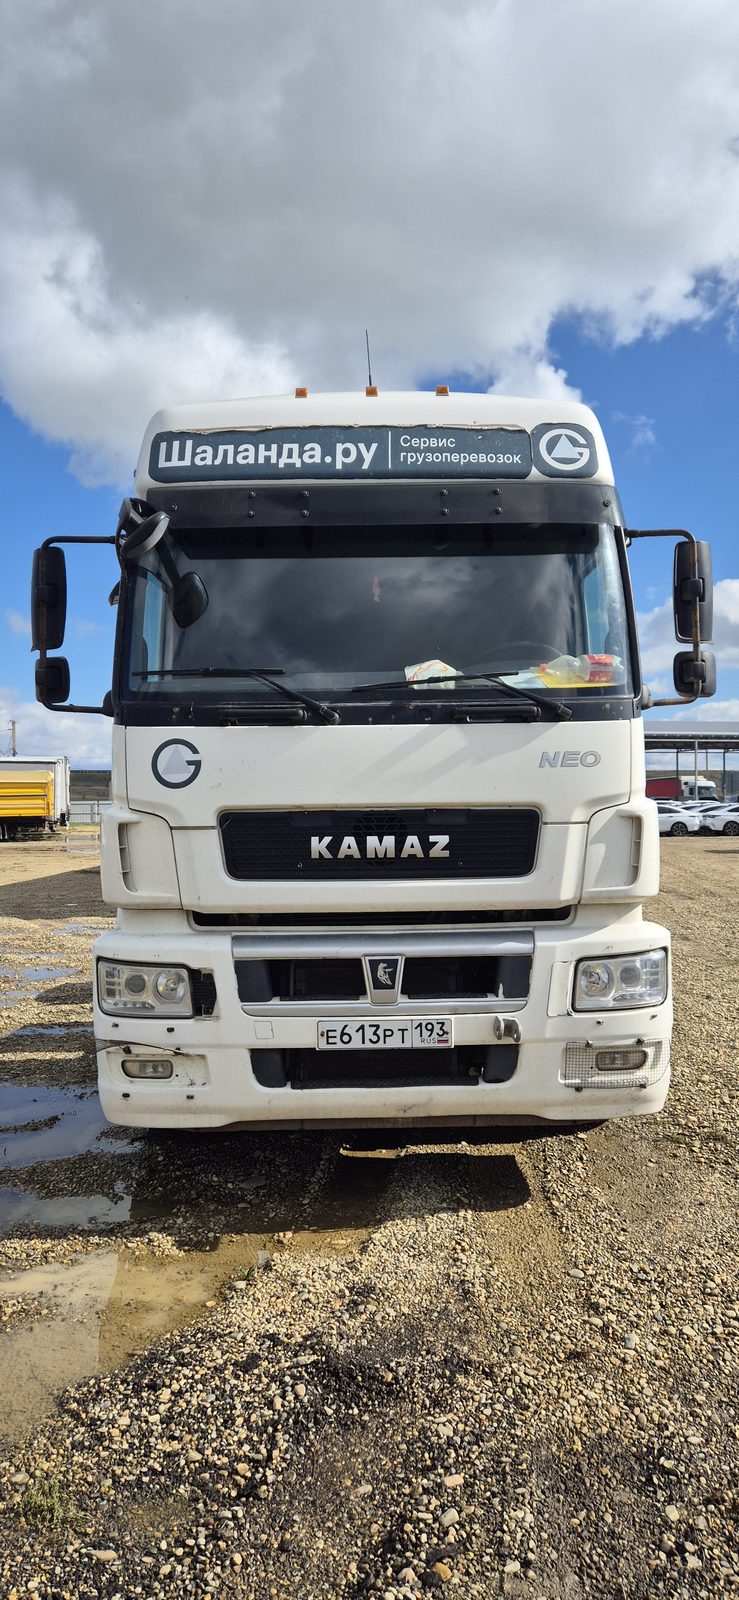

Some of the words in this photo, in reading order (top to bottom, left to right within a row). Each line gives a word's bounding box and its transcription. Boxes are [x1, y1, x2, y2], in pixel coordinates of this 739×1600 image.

[399, 434, 456, 449] Сервис
[157, 439, 379, 469] Шаланда.ру
[399, 450, 523, 466] грузоперевозок
[538, 750, 602, 768] NEO
[310, 835, 451, 860] KAMAZ
[414, 1022, 446, 1037] 193
[420, 1037, 437, 1045] RUS
